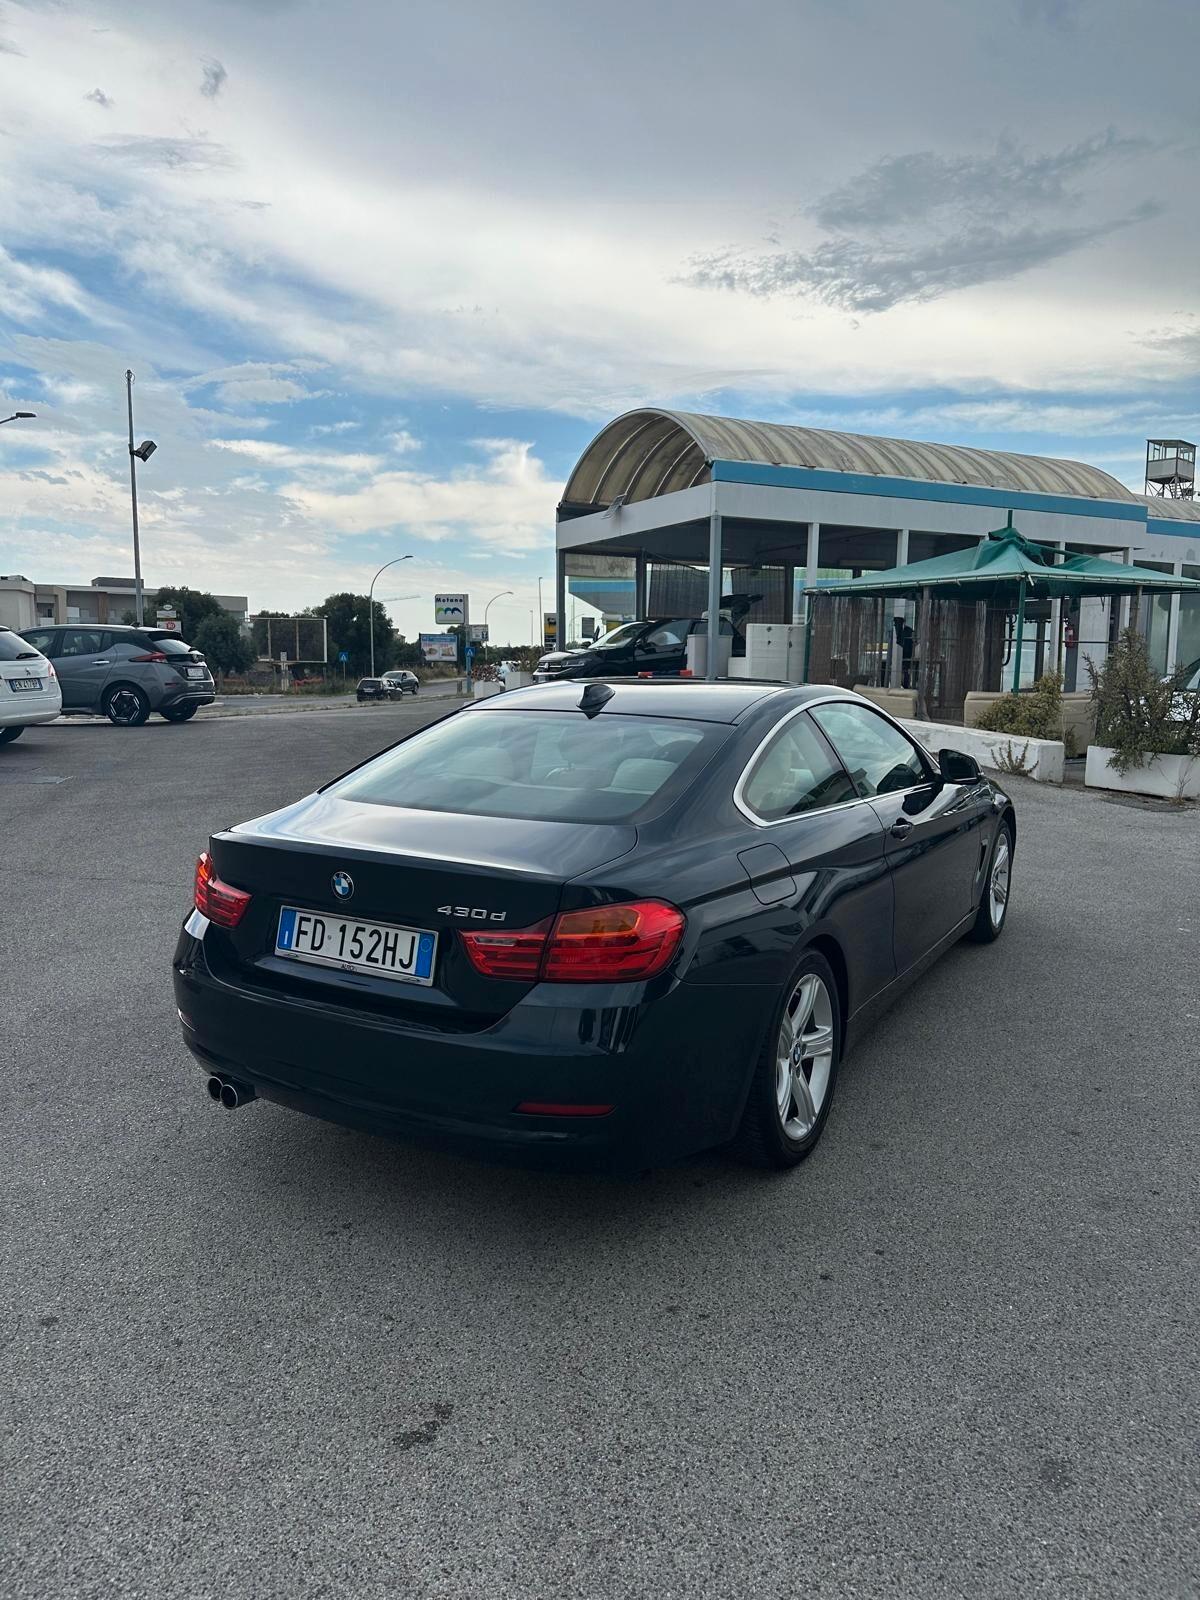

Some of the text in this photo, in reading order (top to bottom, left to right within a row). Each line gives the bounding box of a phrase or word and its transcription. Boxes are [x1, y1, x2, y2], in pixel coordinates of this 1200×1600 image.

[436, 905, 507, 922] 430d
[295, 915, 326, 952] FD
[338, 923, 416, 970] 152HJ
